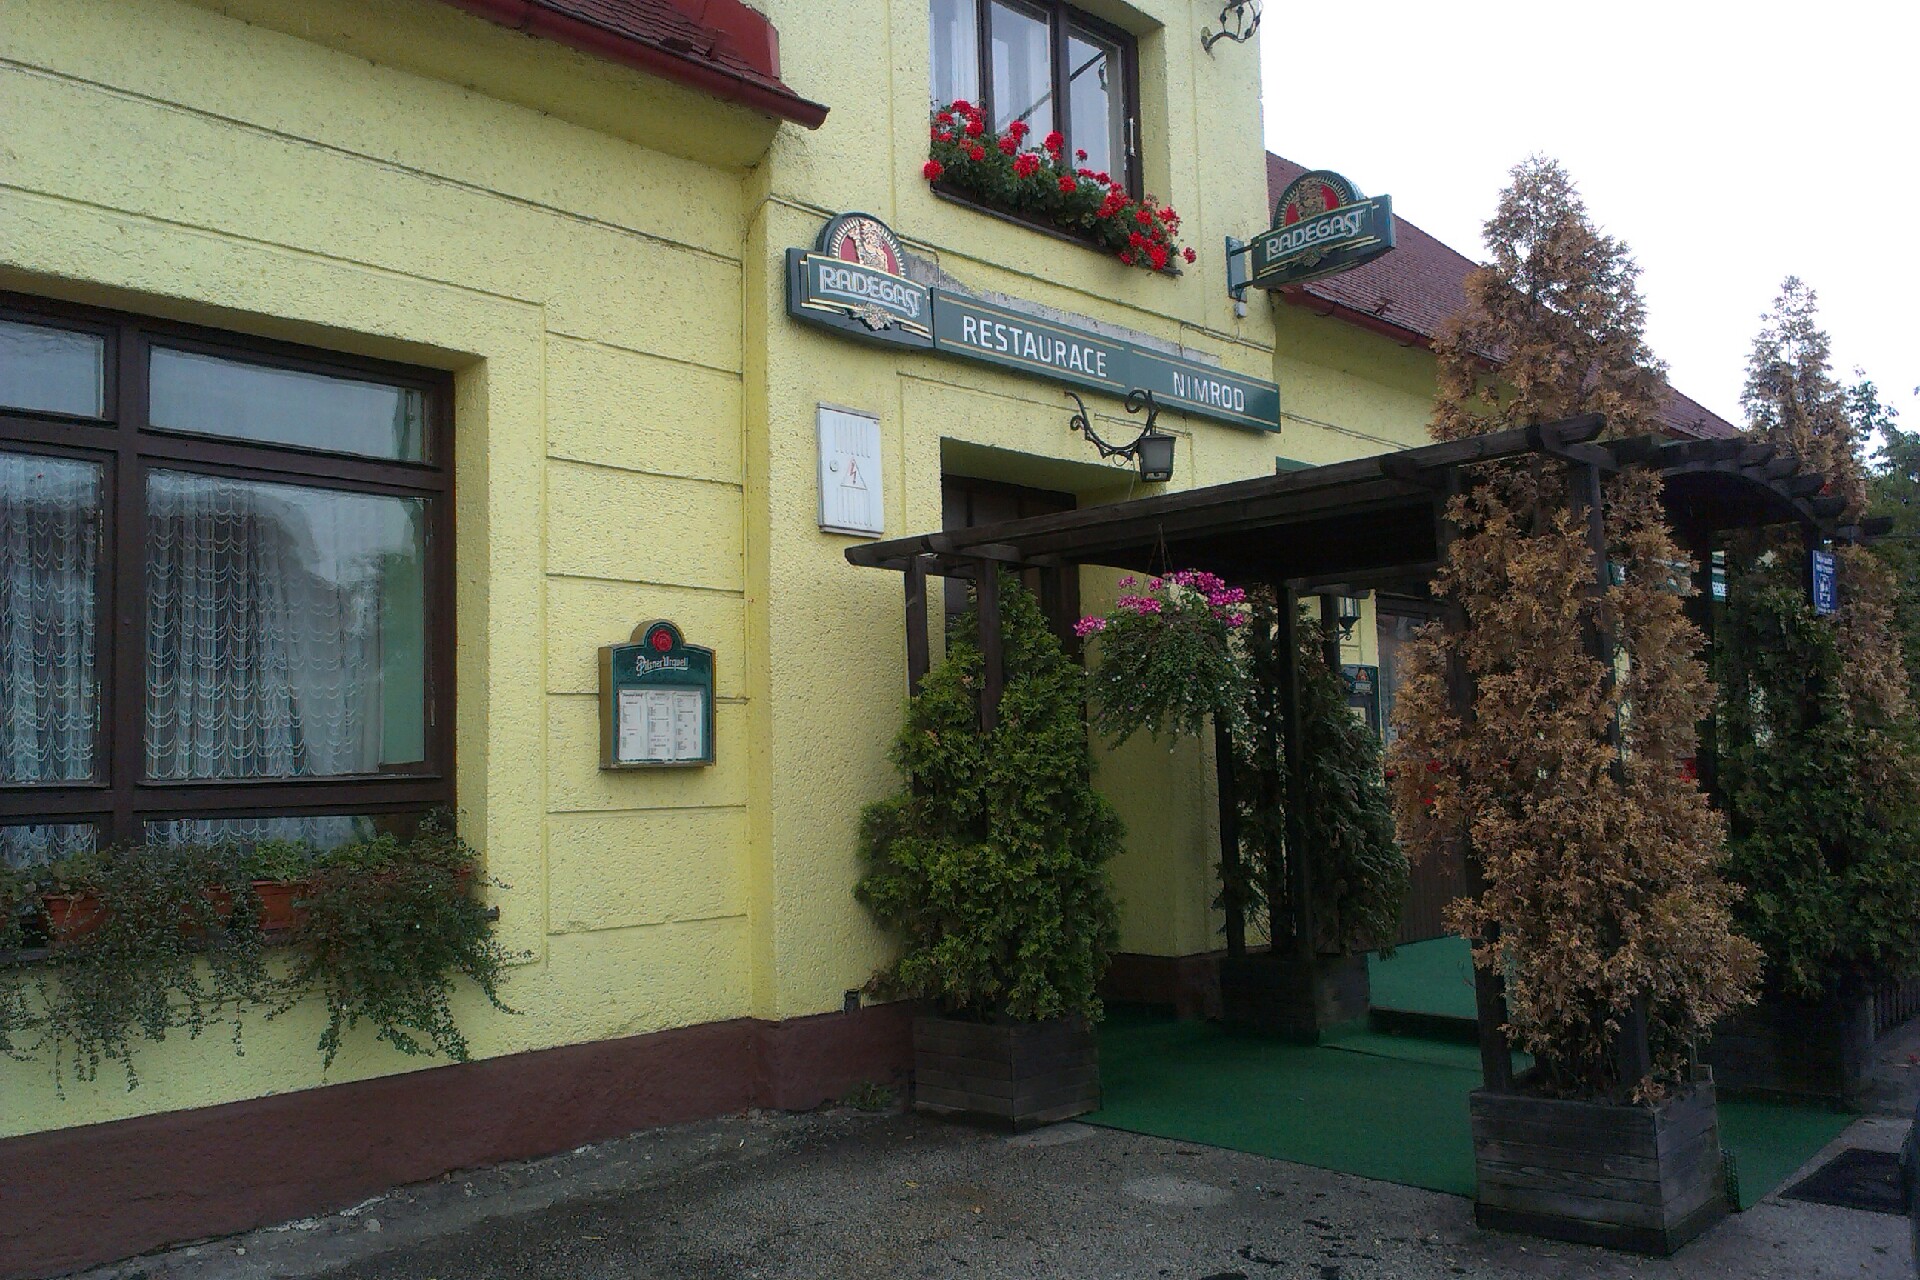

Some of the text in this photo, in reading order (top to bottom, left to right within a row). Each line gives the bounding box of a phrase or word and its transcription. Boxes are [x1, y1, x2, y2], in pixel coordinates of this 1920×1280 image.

[1265, 209, 1364, 261] RADEGAST
[818, 263, 922, 319] RADEGAST
[962, 314, 1246, 413] RESTAURACE NIMROD
[635, 655, 689, 677] Pilsner Urquell
